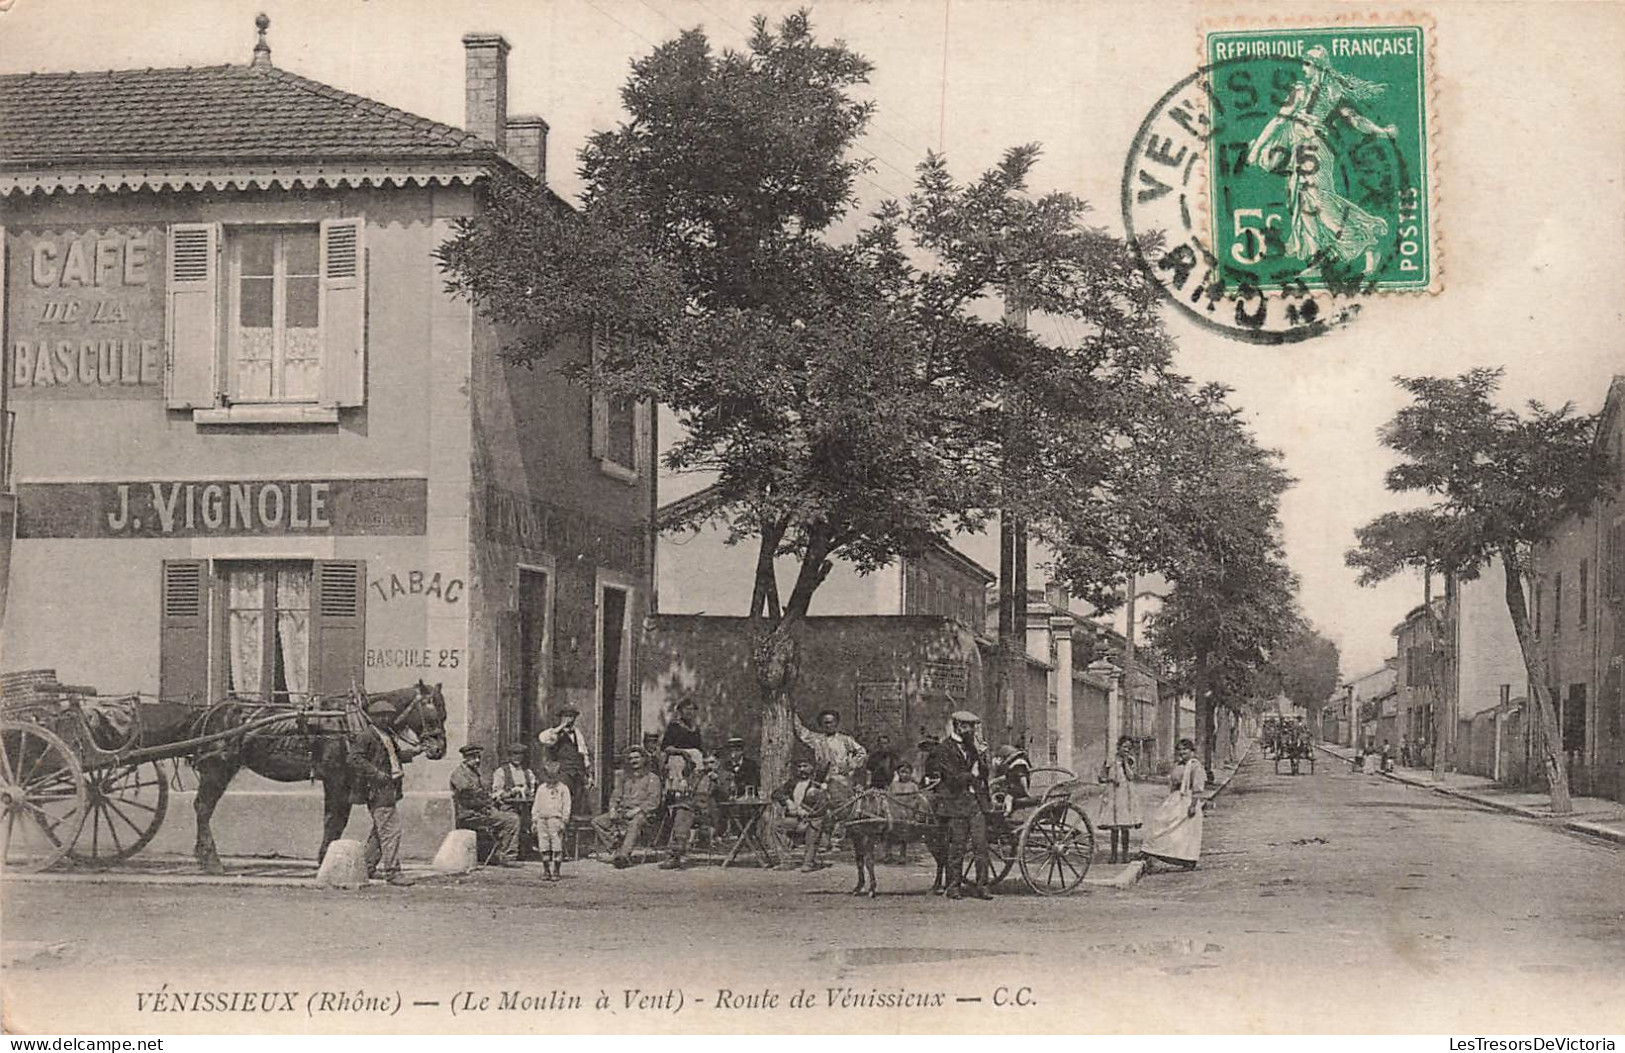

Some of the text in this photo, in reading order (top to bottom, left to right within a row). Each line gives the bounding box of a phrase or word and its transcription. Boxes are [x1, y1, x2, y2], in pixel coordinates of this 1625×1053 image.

[1331, 37, 1414, 58] FRANÇAISE
[1400, 187, 1419, 272] POSTES
[31, 228, 149, 288] CAFÉ
[38, 301, 129, 325] DE LA
[12, 339, 159, 388] BASCULE
[107, 484, 141, 530] J.
[370, 570, 463, 603] TABAC
[366, 649, 459, 668] BASCULE 25
[136, 984, 299, 1012] VÉNISSIEUX
[306, 990, 402, 1017] (Rhône)
[451, 991, 490, 1016] (Le
[498, 991, 582, 1010] Moulin
[596, 990, 610, 1010] à
[623, 989, 685, 1014] Vent)
[715, 989, 779, 1009] Route
[790, 989, 816, 1009] de
[826, 988, 946, 1008] Vénissieux
[993, 987, 1037, 1006] C.C.
